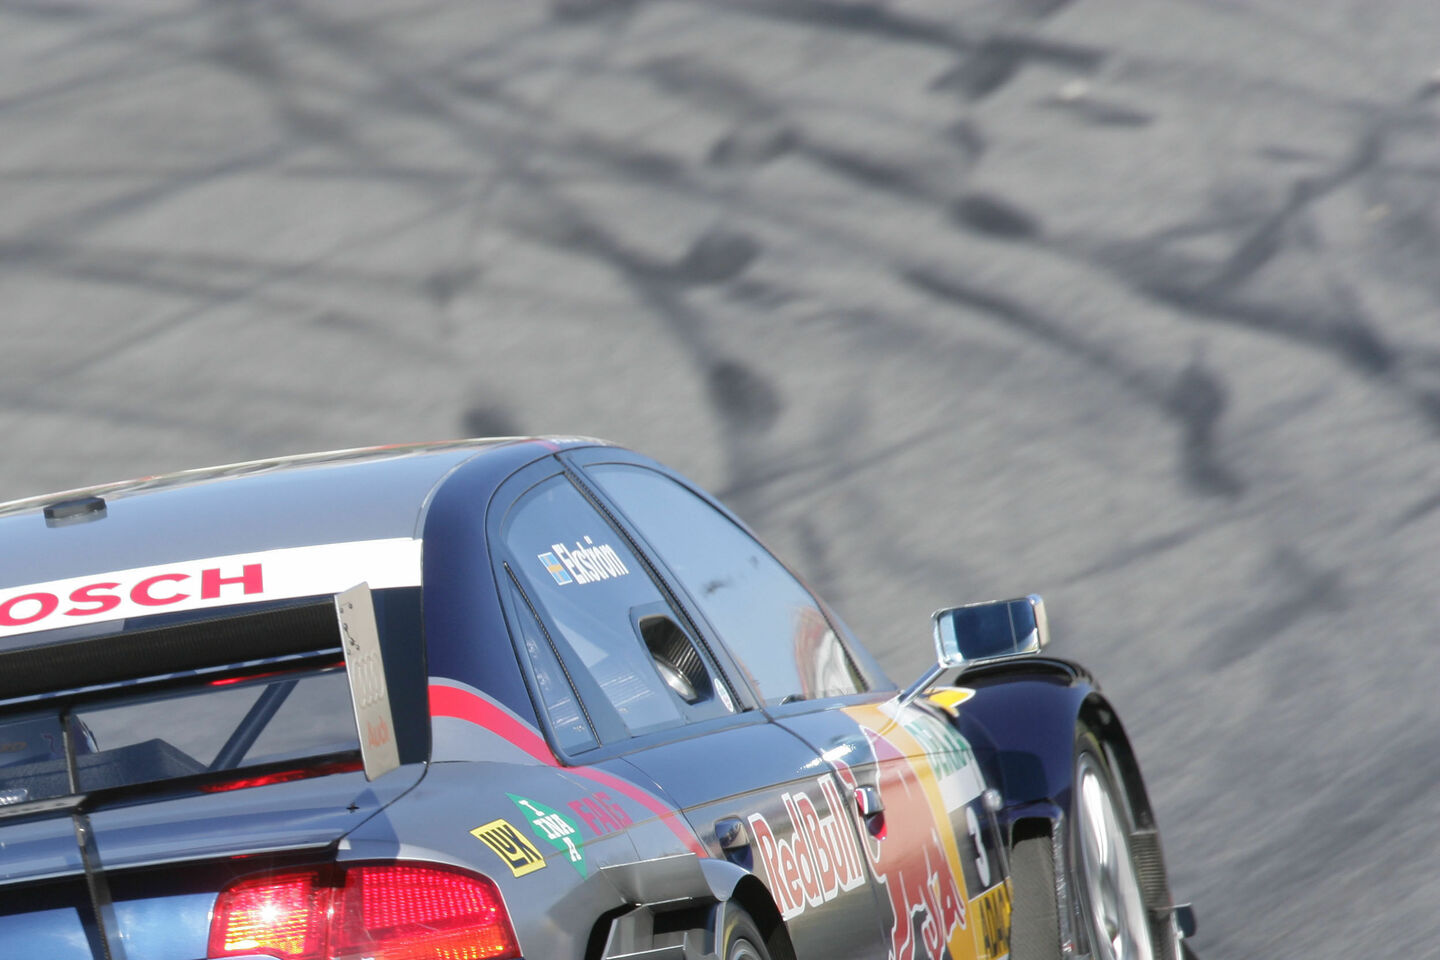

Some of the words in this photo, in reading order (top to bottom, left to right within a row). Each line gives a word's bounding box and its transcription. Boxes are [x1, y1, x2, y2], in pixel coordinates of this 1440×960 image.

[551, 535, 629, 584] Ekström
[567, 791, 634, 836] FAG
[965, 805, 991, 887] 3
[747, 792, 824, 922] Red
[793, 773, 866, 902] Bull
